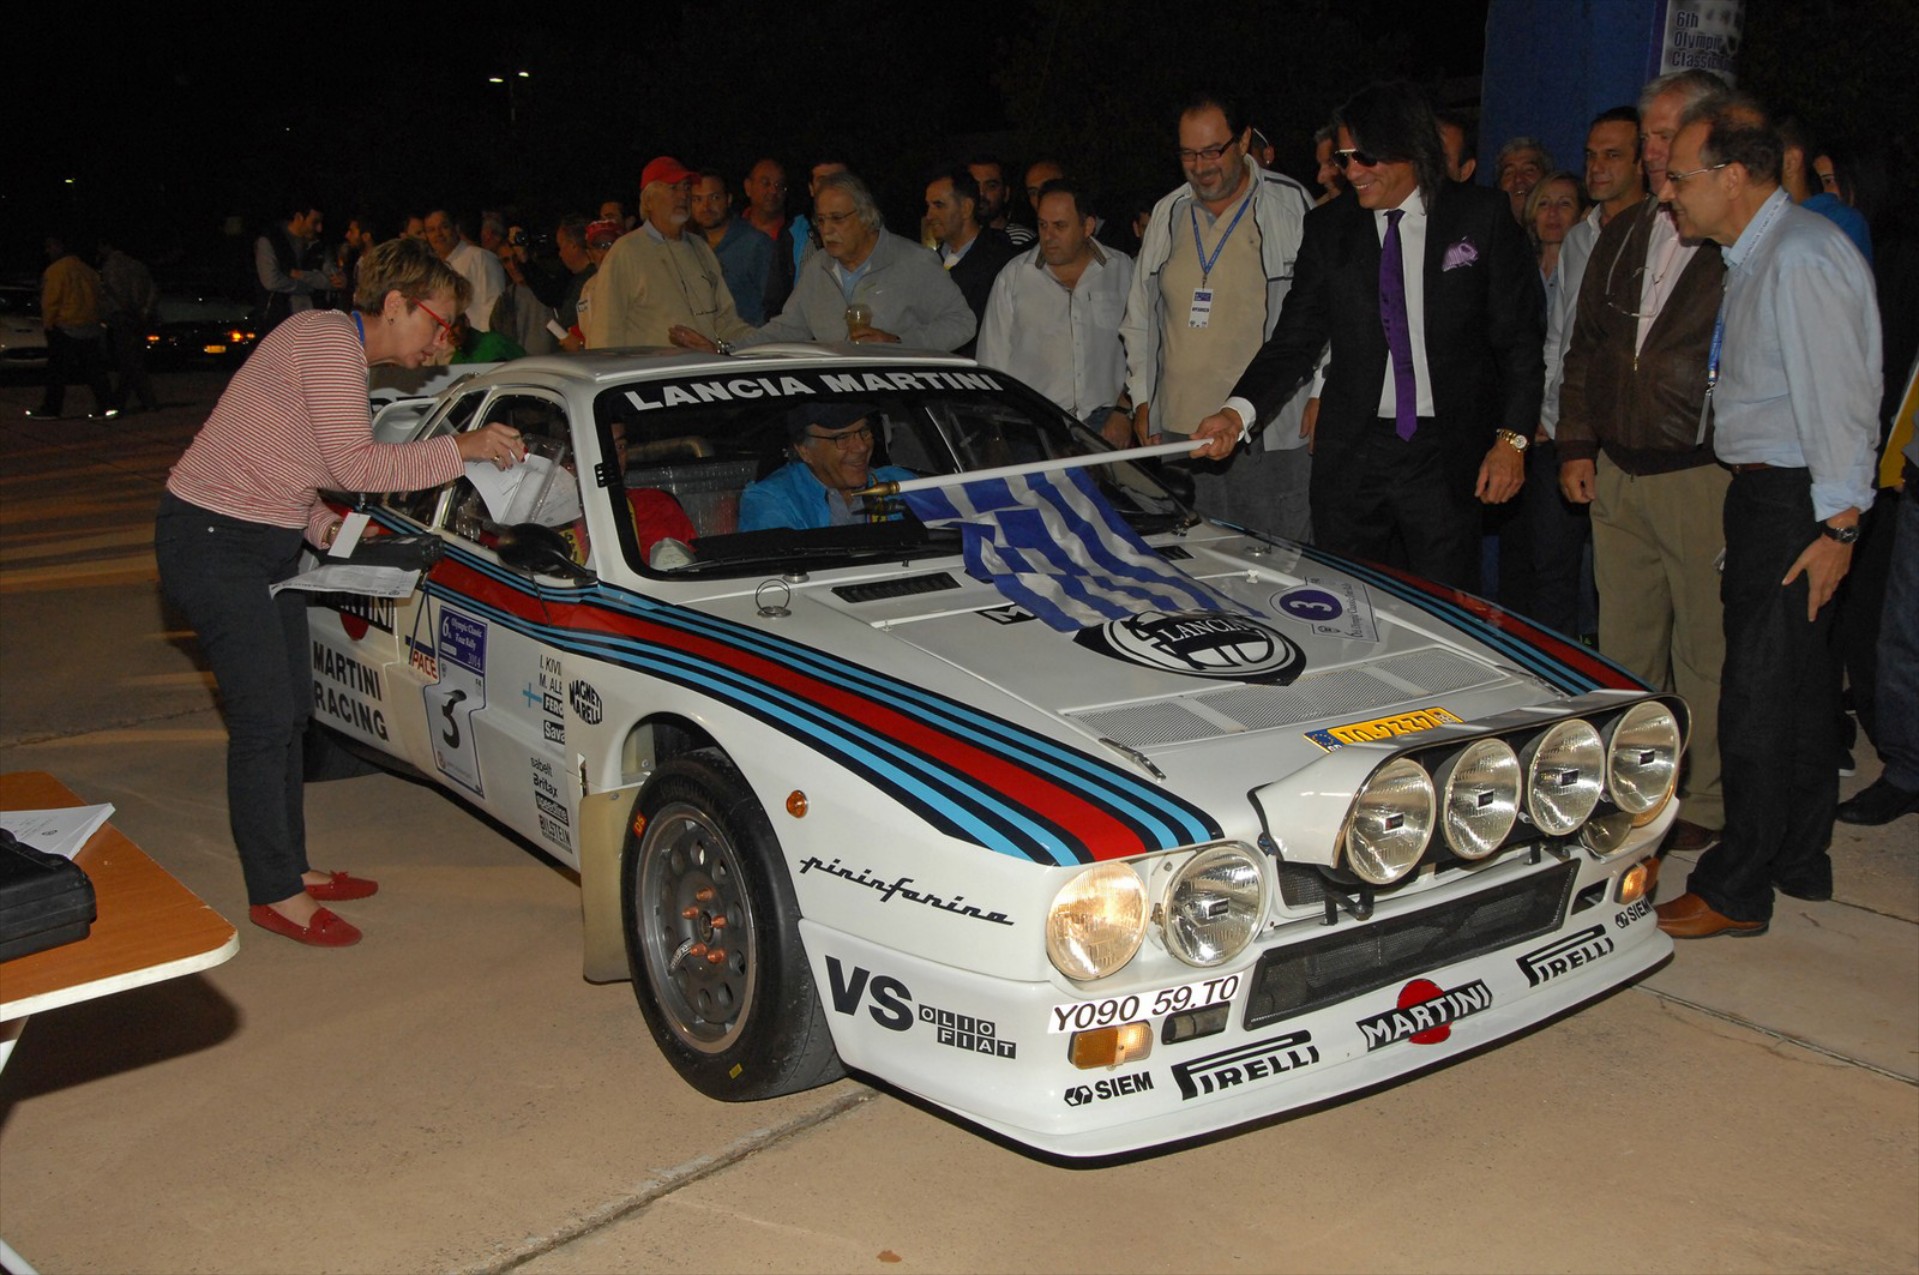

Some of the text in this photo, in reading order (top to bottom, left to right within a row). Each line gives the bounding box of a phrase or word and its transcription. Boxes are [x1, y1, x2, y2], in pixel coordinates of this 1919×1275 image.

[1675, 11, 1699, 28] 6th
[1674, 31, 1724, 51] Olympic
[624, 371, 1004, 412] LANCIA MARTINI
[1288, 600, 1333, 613] 3
[1156, 618, 1251, 642] LANCIA
[313, 640, 383, 702] MARTINI
[313, 680, 389, 742] RACING
[441, 689, 467, 749] 3
[533, 773, 559, 798] Britax
[799, 856, 1015, 926] pininfarina
[1627, 897, 1652, 921] SIEM
[1515, 924, 1615, 988] PIRELLI
[824, 954, 994, 1036] VS OLIO
[1360, 984, 1492, 1049] MARTINI
[939, 1030, 1015, 1057] FIAT
[1094, 1070, 1155, 1100] SIEM
[1170, 1029, 1320, 1101] PIRELLI
